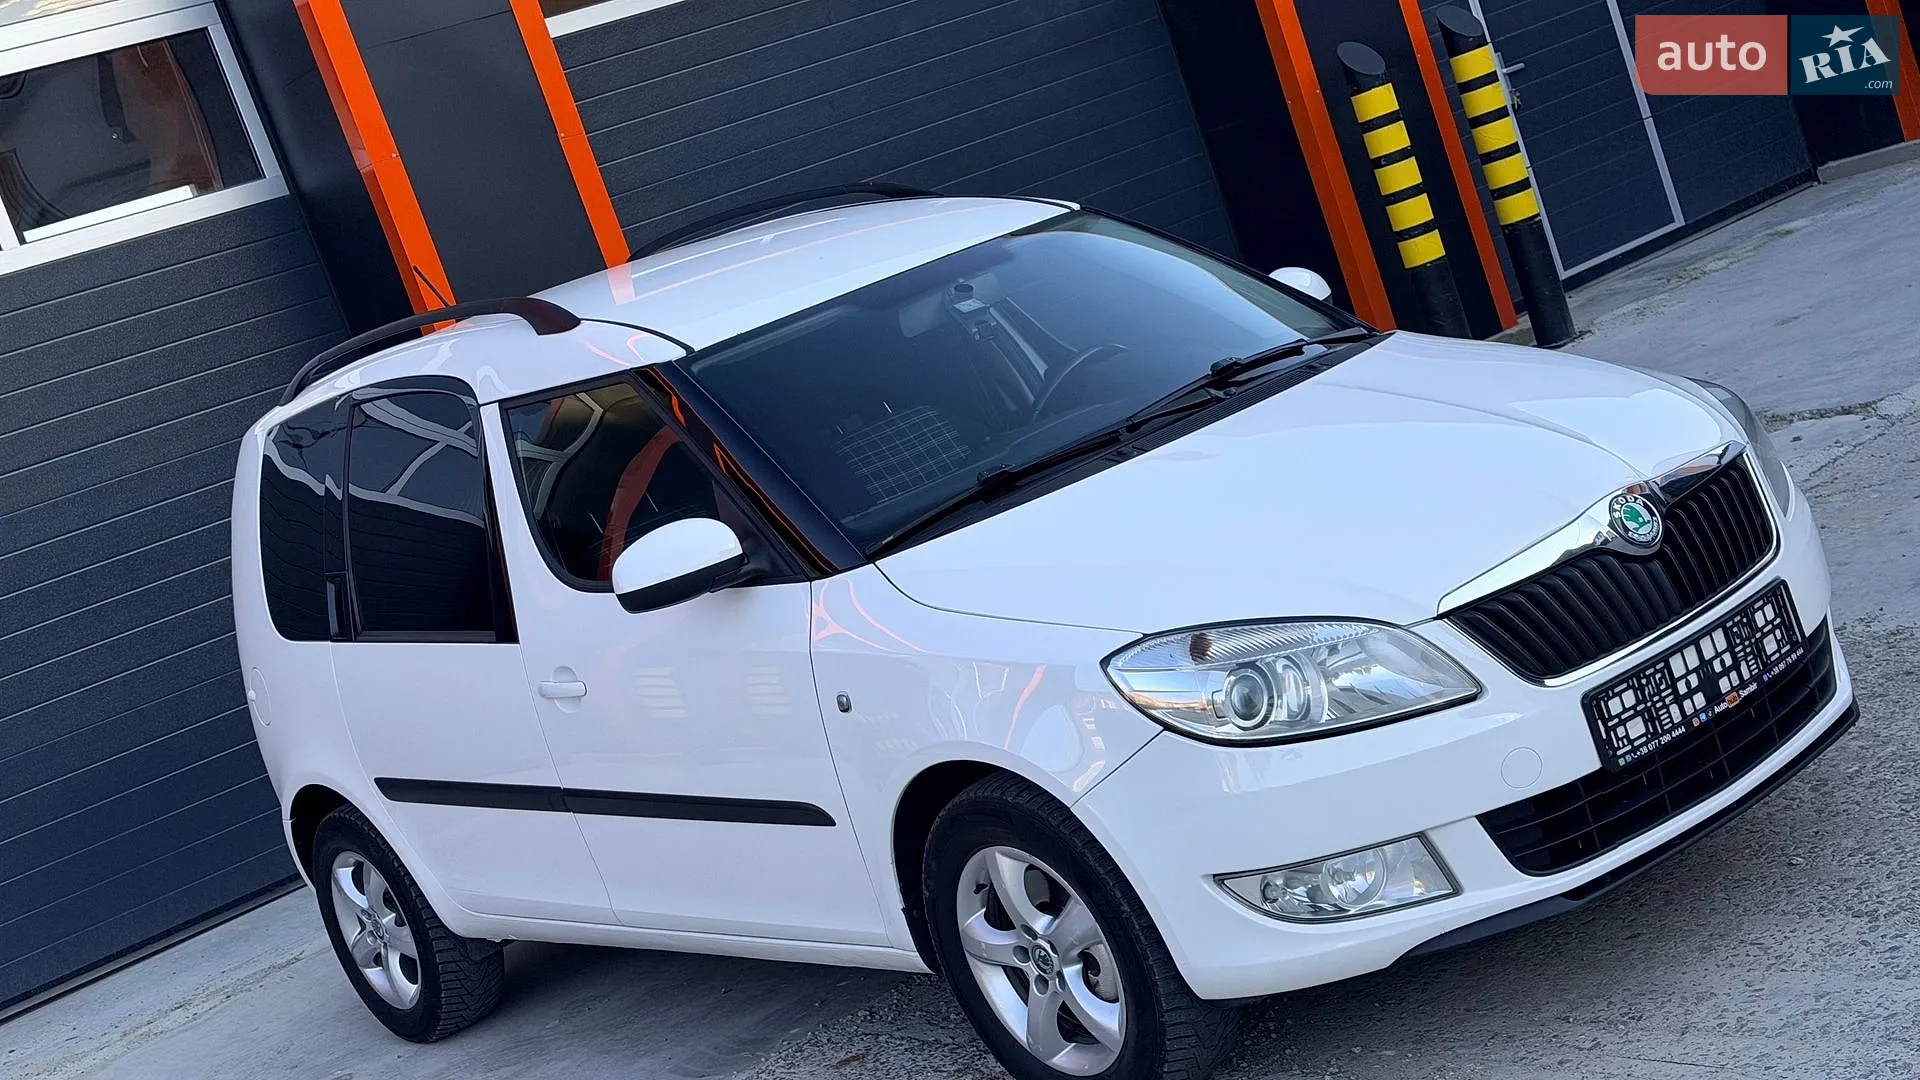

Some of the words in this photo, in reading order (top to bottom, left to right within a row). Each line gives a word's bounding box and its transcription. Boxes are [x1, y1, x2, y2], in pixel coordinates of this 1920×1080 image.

[1714, 701, 1728, 714] Auto
[1647, 740, 1659, 751] 077
[1659, 733, 1672, 745] 200
[1671, 725, 1686, 738] 4444
